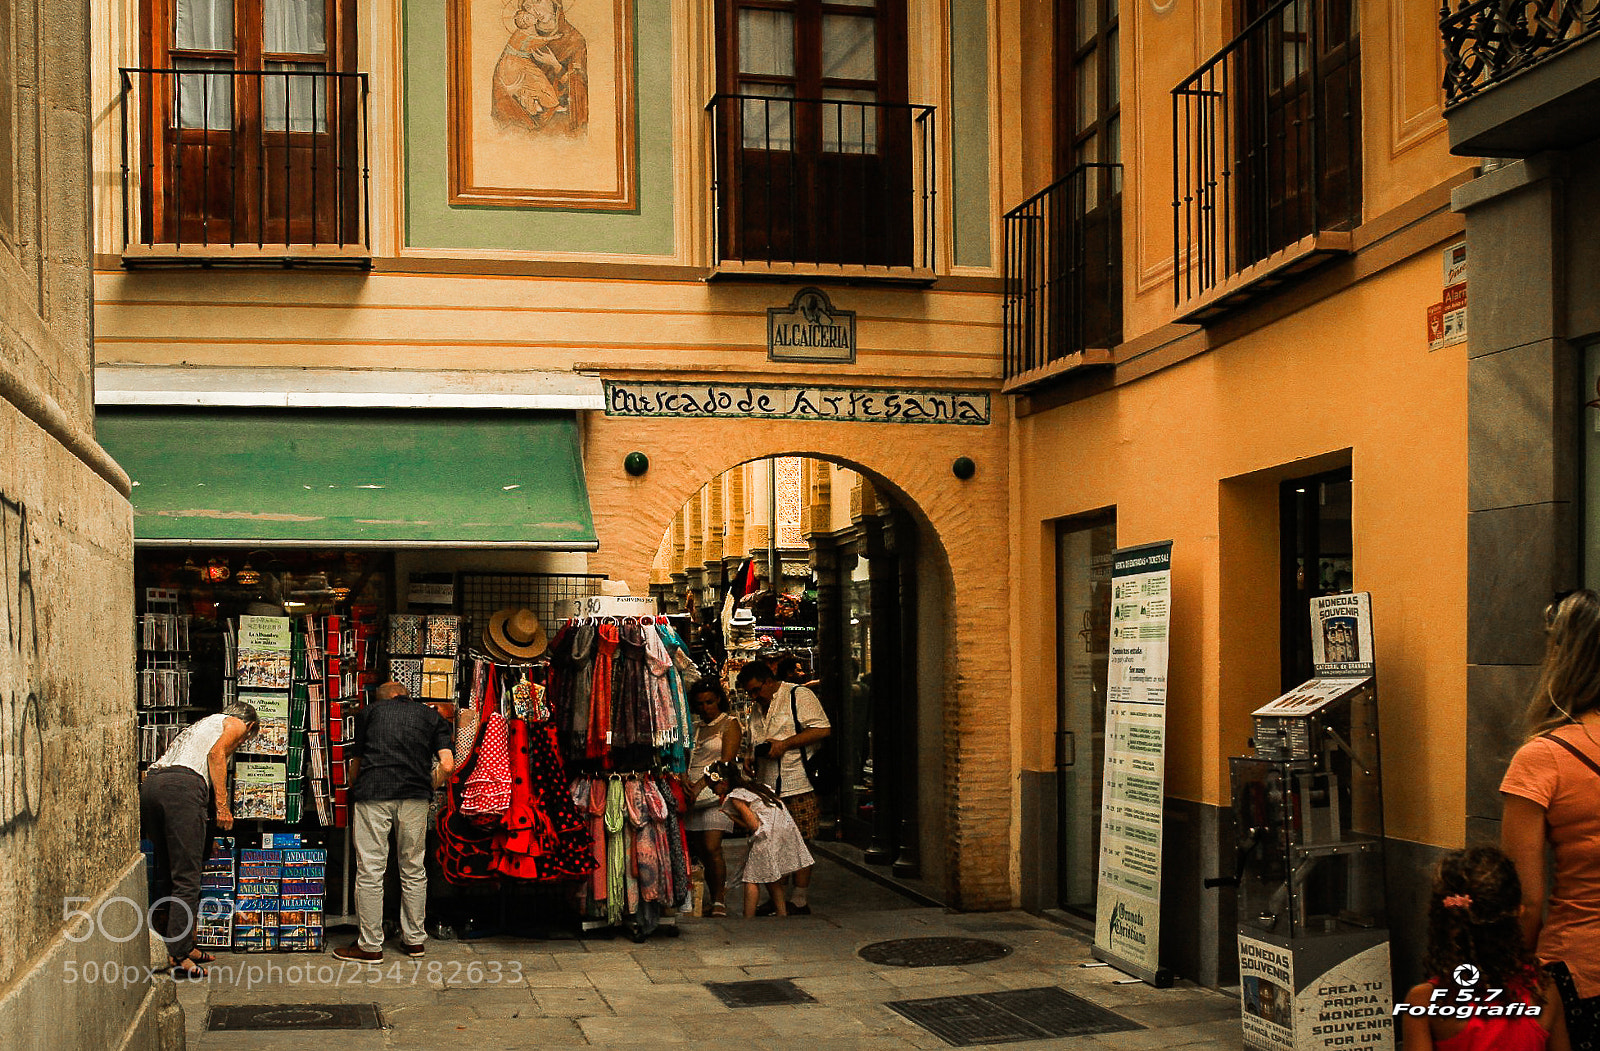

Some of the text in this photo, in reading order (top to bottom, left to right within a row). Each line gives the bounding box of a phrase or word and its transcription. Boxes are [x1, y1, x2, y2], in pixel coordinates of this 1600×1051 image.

[773, 324, 850, 349] ALCAICERIA
[610, 384, 731, 415] Mercado
[736, 387, 777, 413] de
[1318, 596, 1358, 608] MONEDAS
[1319, 608, 1359, 620] SOUVENIR
[1240, 942, 1290, 969] MONEDAS
[1241, 957, 1290, 984] SOUVENIR
[1319, 981, 1383, 996] CREA TU
[1324, 994, 1379, 1008] PROPIA
[1319, 1007, 1385, 1022] MONEDA
[1312, 1018, 1392, 1035] SOUVENIR
[1324, 1033, 1382, 1047] POR UN
